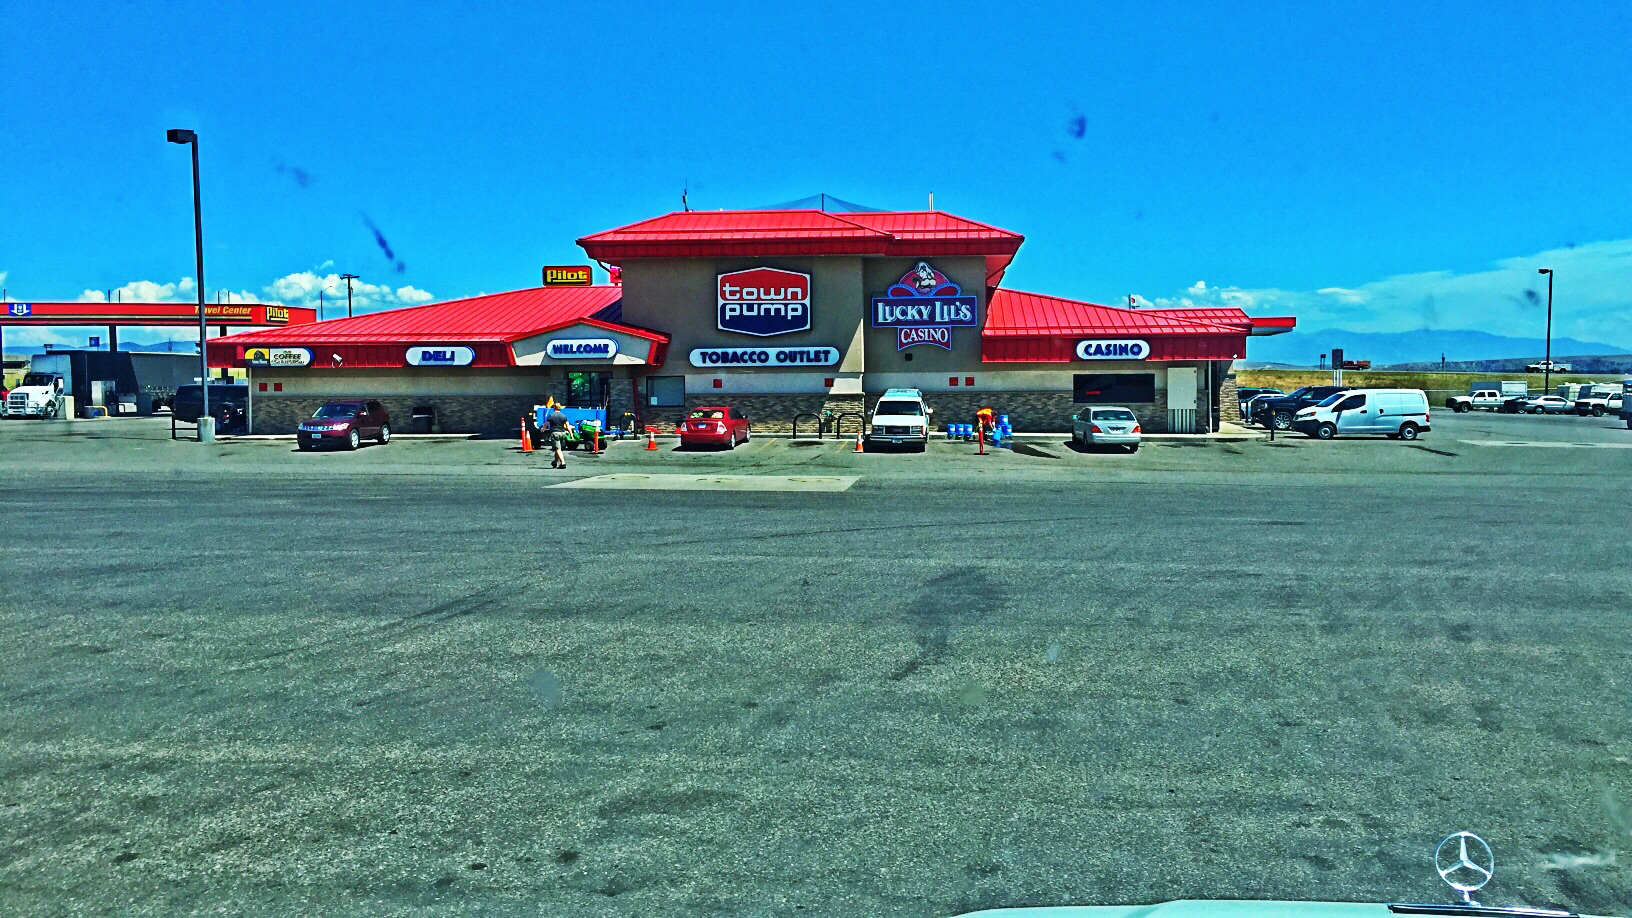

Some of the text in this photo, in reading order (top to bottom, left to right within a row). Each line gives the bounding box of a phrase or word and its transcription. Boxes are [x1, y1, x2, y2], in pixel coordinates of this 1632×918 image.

[546, 269, 588, 283] Pilot
[722, 282, 802, 300] town
[222, 306, 252, 314] Center
[266, 306, 289, 320] Pilot
[725, 304, 803, 320] pump
[877, 301, 973, 323] LUCKY LIL'S
[900, 328, 949, 344] CASINO
[421, 350, 455, 362] DELI
[552, 343, 610, 355] WELCOME
[1084, 343, 1143, 357] CASINO
[699, 349, 831, 364] TOBACCO OUTLET
